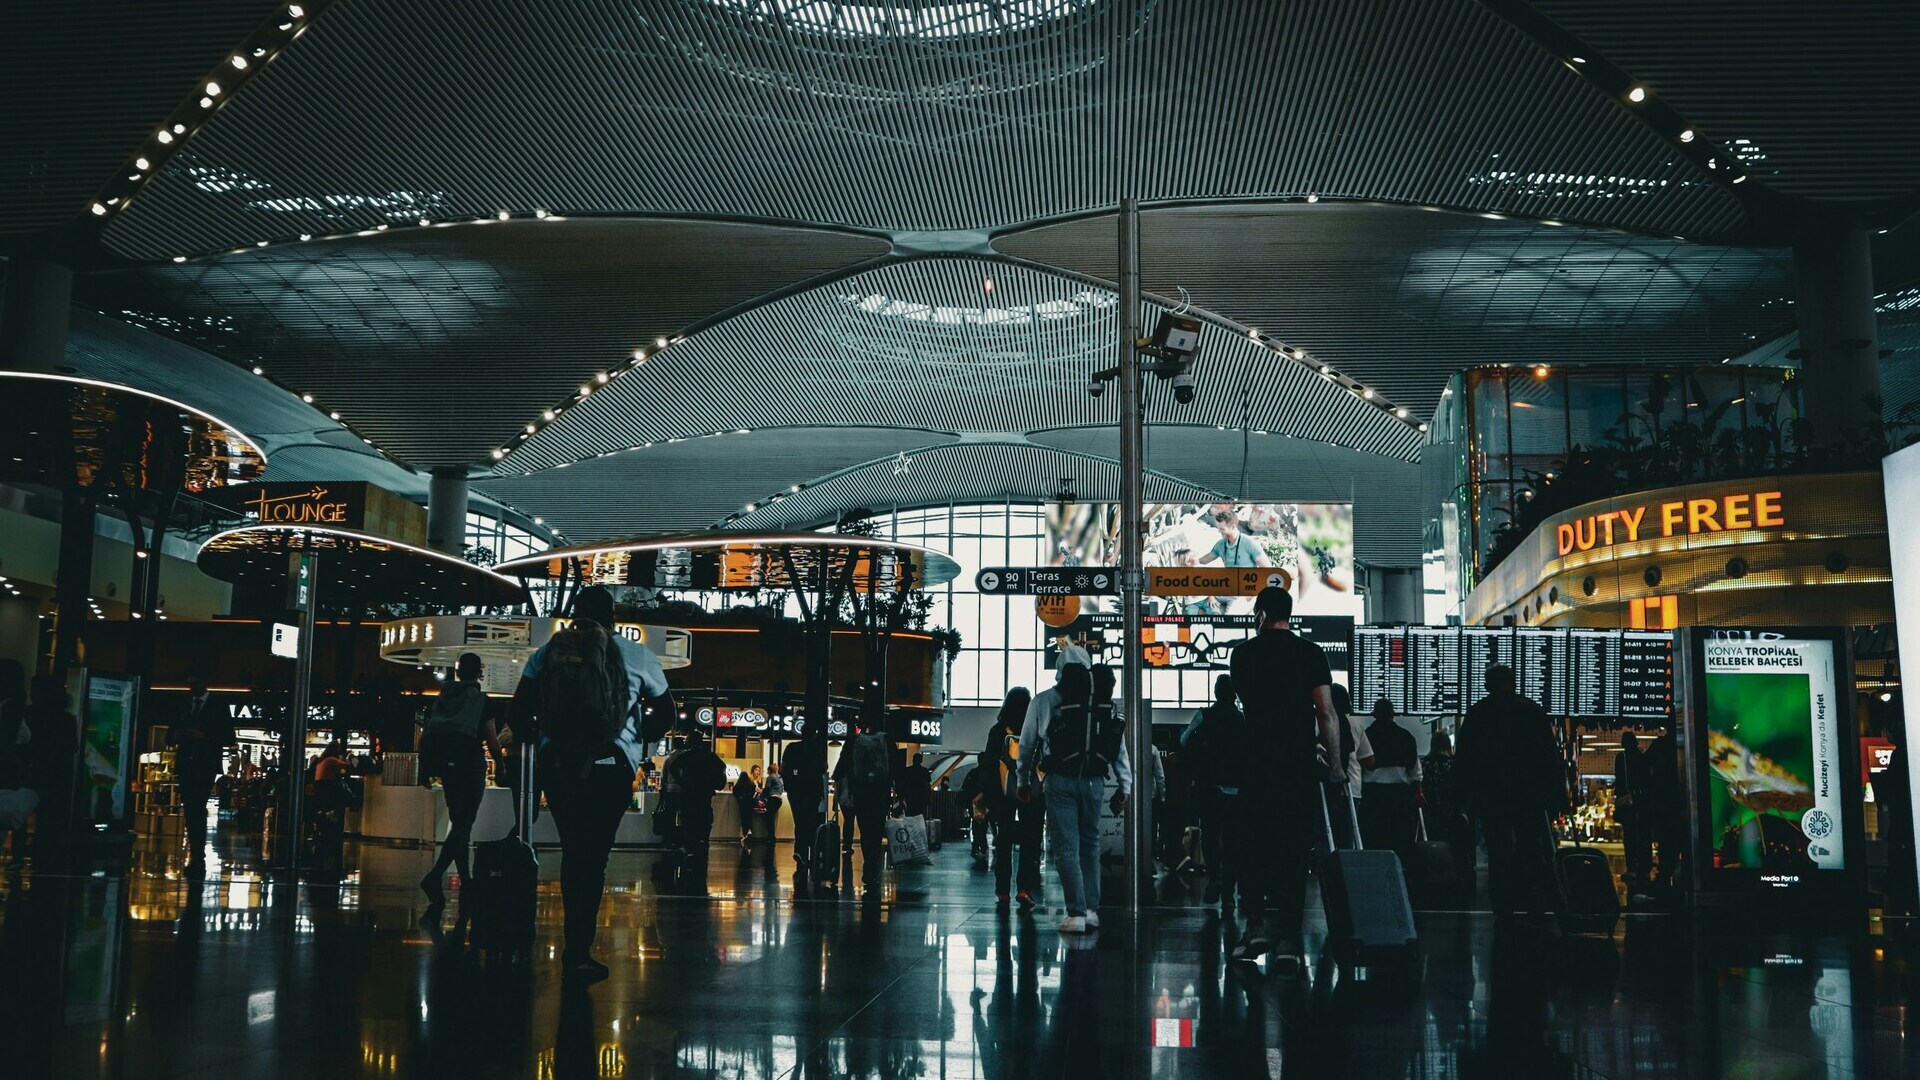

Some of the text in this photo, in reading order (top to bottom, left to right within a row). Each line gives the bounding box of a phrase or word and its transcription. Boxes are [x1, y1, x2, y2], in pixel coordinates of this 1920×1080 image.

[260, 502, 348, 522] LOUNGE
[1556, 491, 1785, 557] DUTY FREE
[1005, 572, 1019, 582] 90
[1029, 571, 1060, 581] Teras
[1155, 575, 1230, 587] Food Court
[1244, 573, 1258, 583] 40
[1029, 583, 1071, 594] Terrace
[1708, 645, 1798, 656] KONYA TROPİKAL
[1708, 655, 1803, 668] KELEBEK BAHÇESİ
[1817, 693, 1825, 720] Keşfet
[911, 719, 941, 737] BOSS
[1820, 760, 1829, 798] Mucizeyi
